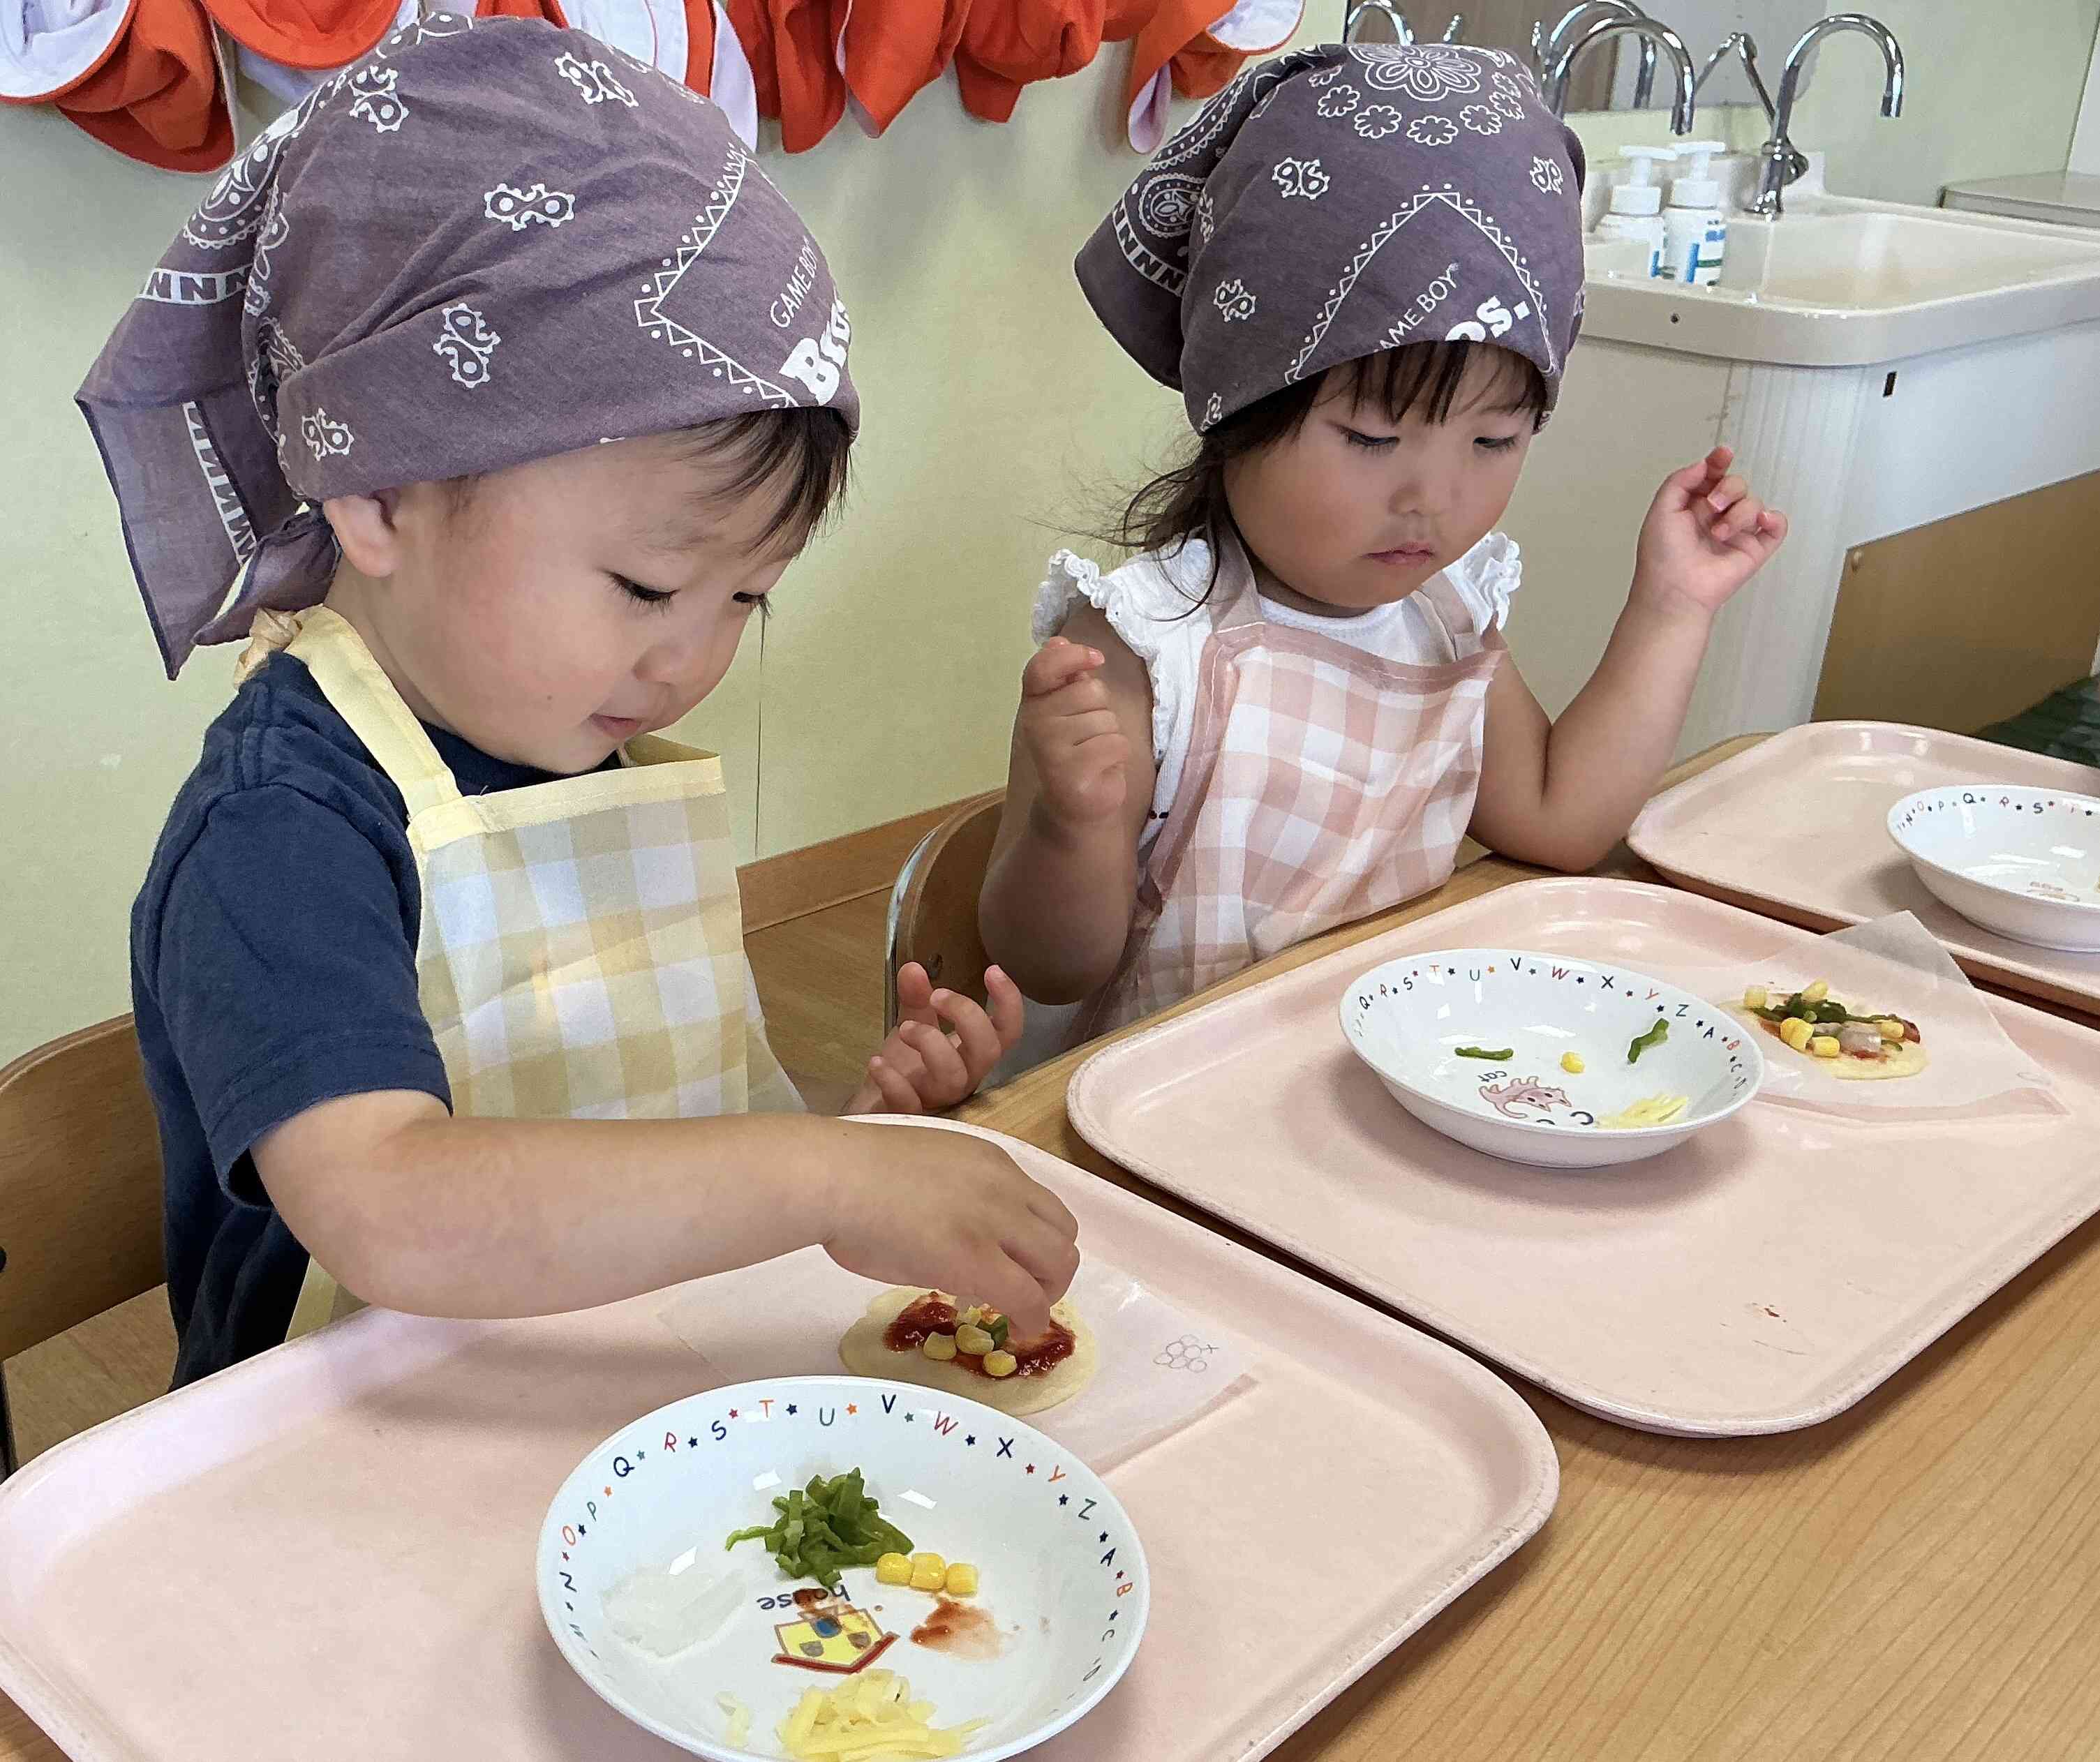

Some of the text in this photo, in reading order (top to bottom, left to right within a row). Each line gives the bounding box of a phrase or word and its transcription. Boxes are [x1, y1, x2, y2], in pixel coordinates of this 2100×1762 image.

[770, 265, 812, 328] GAME
[1373, 268, 1457, 352] AME BOY
[1963, 793, 1976, 804] Q
[2033, 801, 2044, 814] S
[1359, 996, 1371, 1010] Q
[1380, 984, 1388, 997] R
[1403, 976, 1413, 990] S
[1469, 969, 1480, 981] U
[1510, 957, 1521, 971] V
[1551, 966, 1570, 980] W
[1601, 976, 1614, 989] X
[1645, 988, 1659, 1000] Y
[1676, 1003, 1689, 1017] Z
[1703, 1026, 1714, 1038] A
[1477, 1070, 1507, 1082] cat
[759, 1399, 774, 1419] T
[881, 1394, 897, 1414] V
[819, 1407, 835, 1426] U
[933, 1410, 959, 1435] W
[711, 1420, 727, 1440] S
[664, 1432, 676, 1453] R
[996, 1436, 1014, 1458] X
[613, 1456, 635, 1477] Q
[1048, 1464, 1066, 1482] Y
[586, 1501, 597, 1522] P
[1078, 1498, 1097, 1521] Z
[562, 1525, 576, 1546] O
[1100, 1547, 1117, 1567] A
[1116, 1581, 1133, 1597] B
[1101, 1628, 1115, 1642] C
